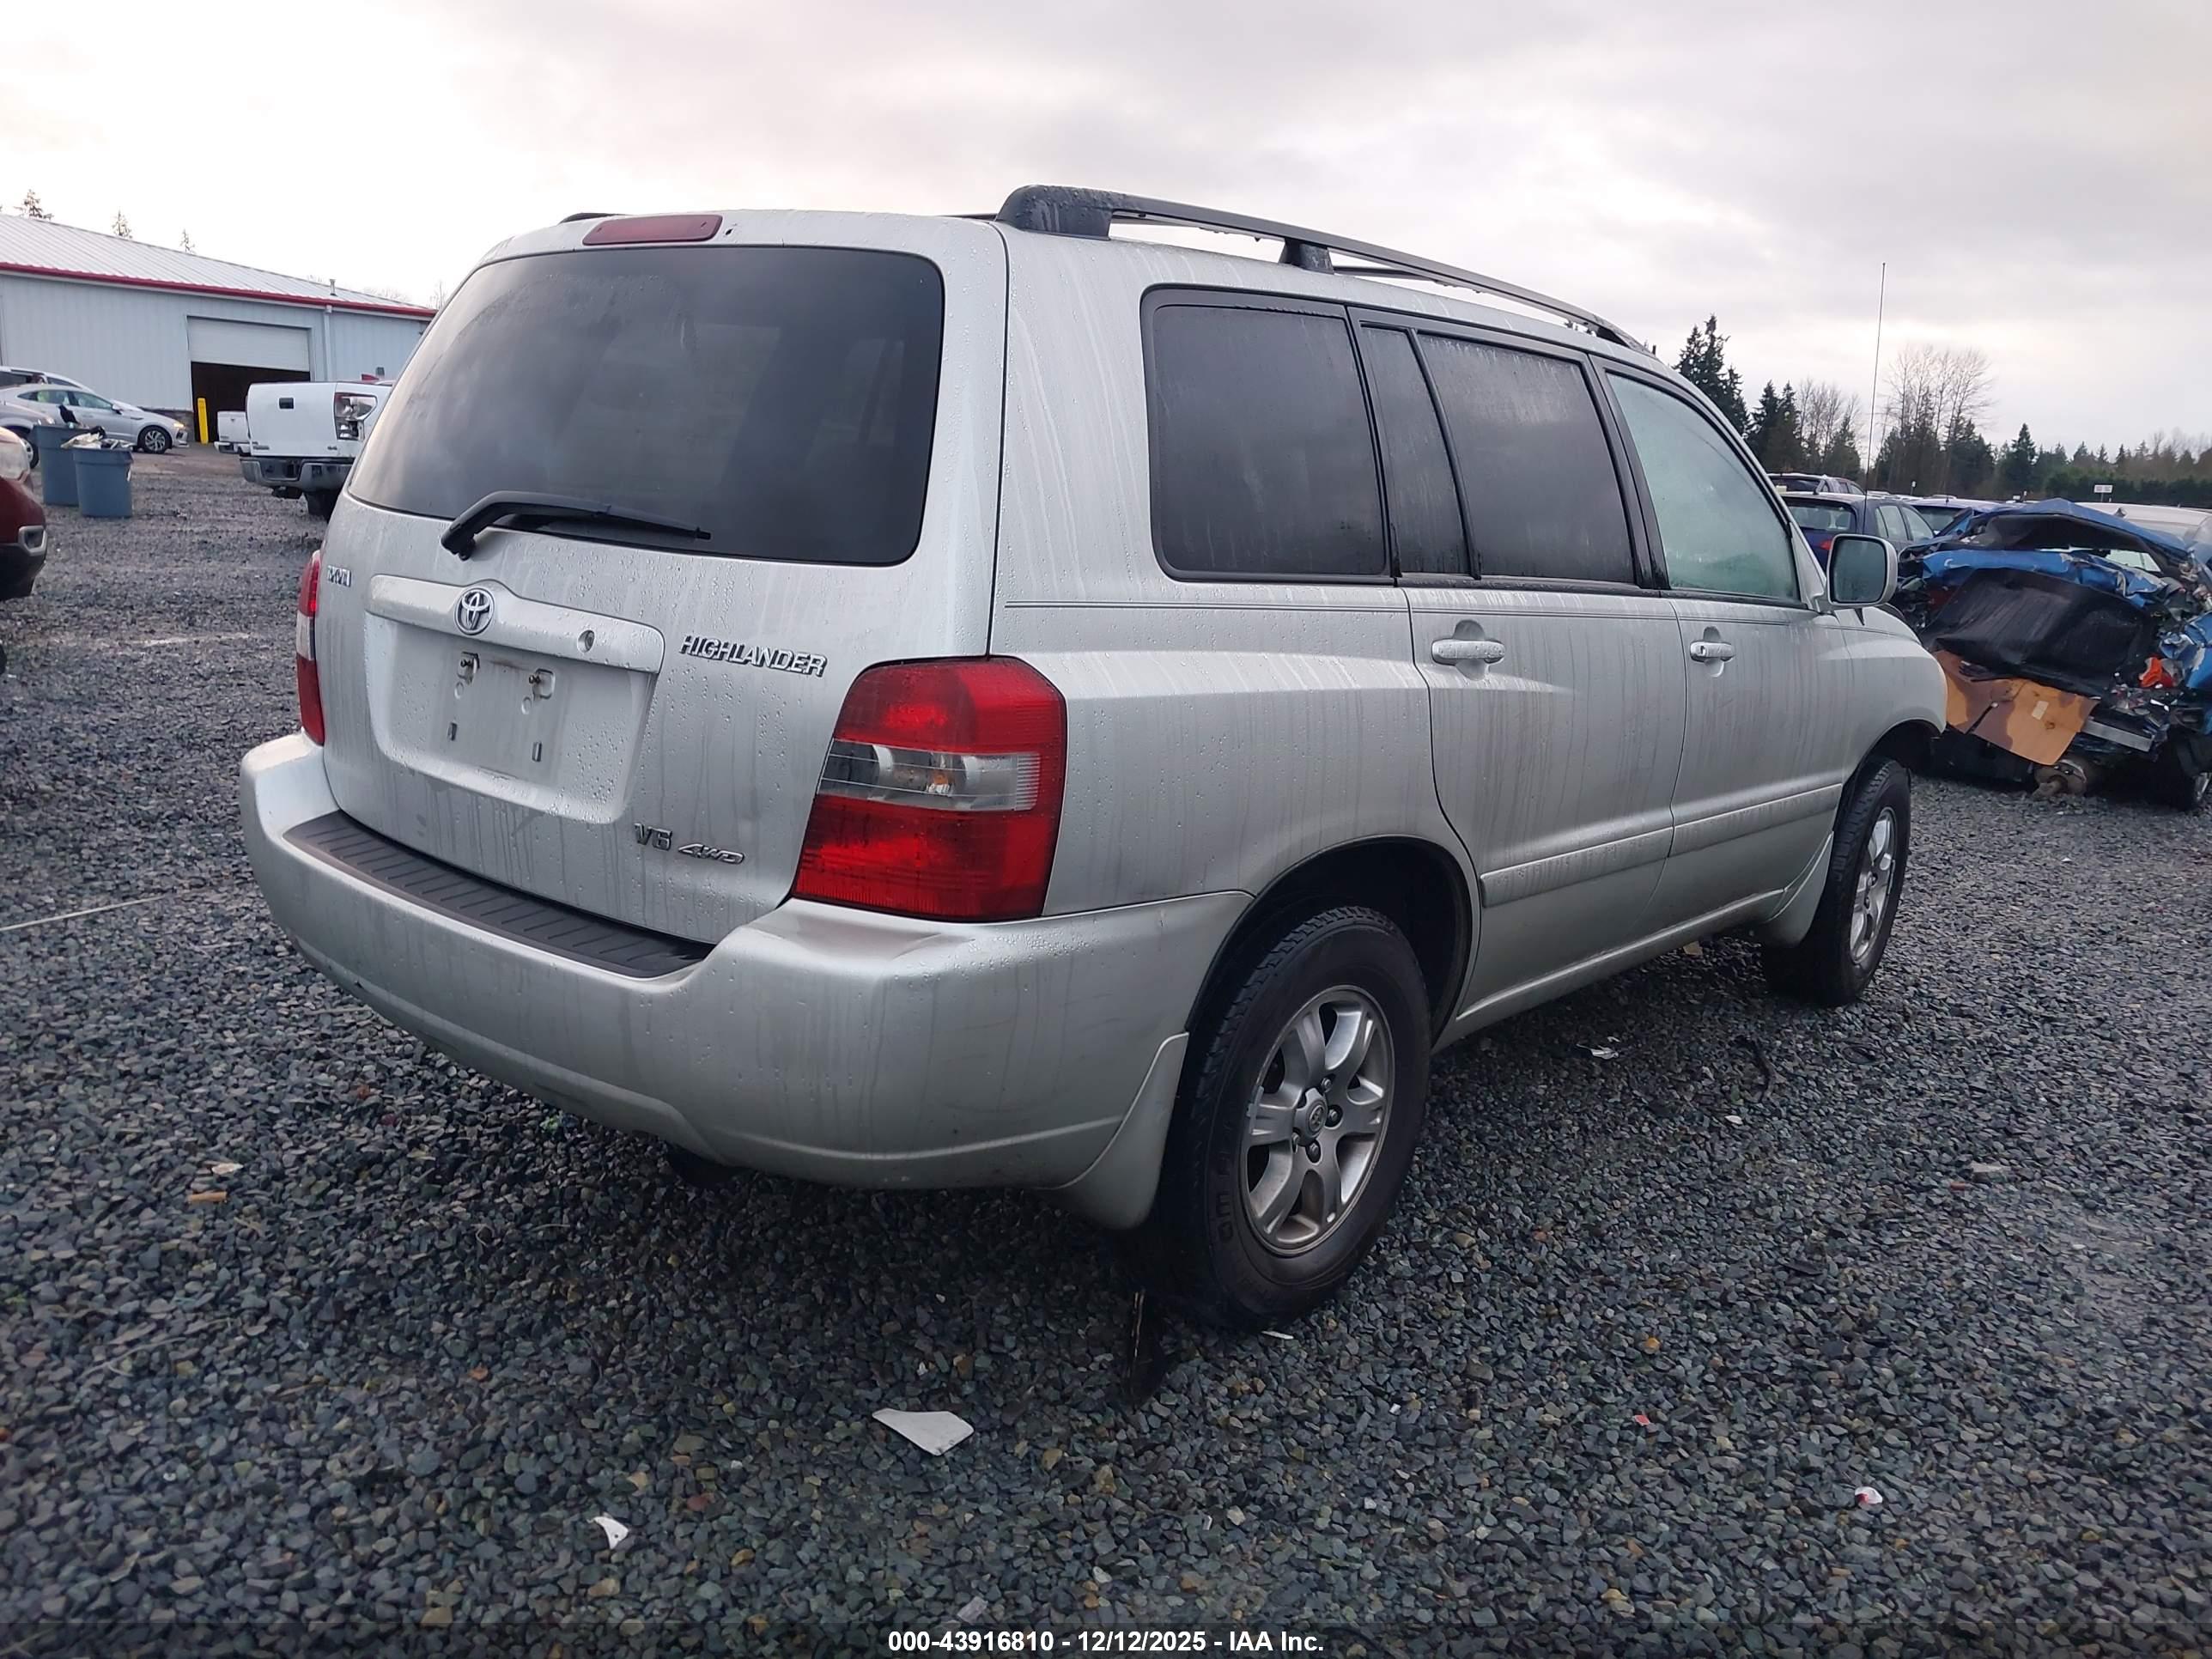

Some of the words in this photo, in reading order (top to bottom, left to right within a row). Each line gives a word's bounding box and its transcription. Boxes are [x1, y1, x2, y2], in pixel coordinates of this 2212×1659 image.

[679, 635, 828, 678] HIGHLANDER
[635, 822, 672, 851] V6
[678, 843, 744, 865] 4WD
